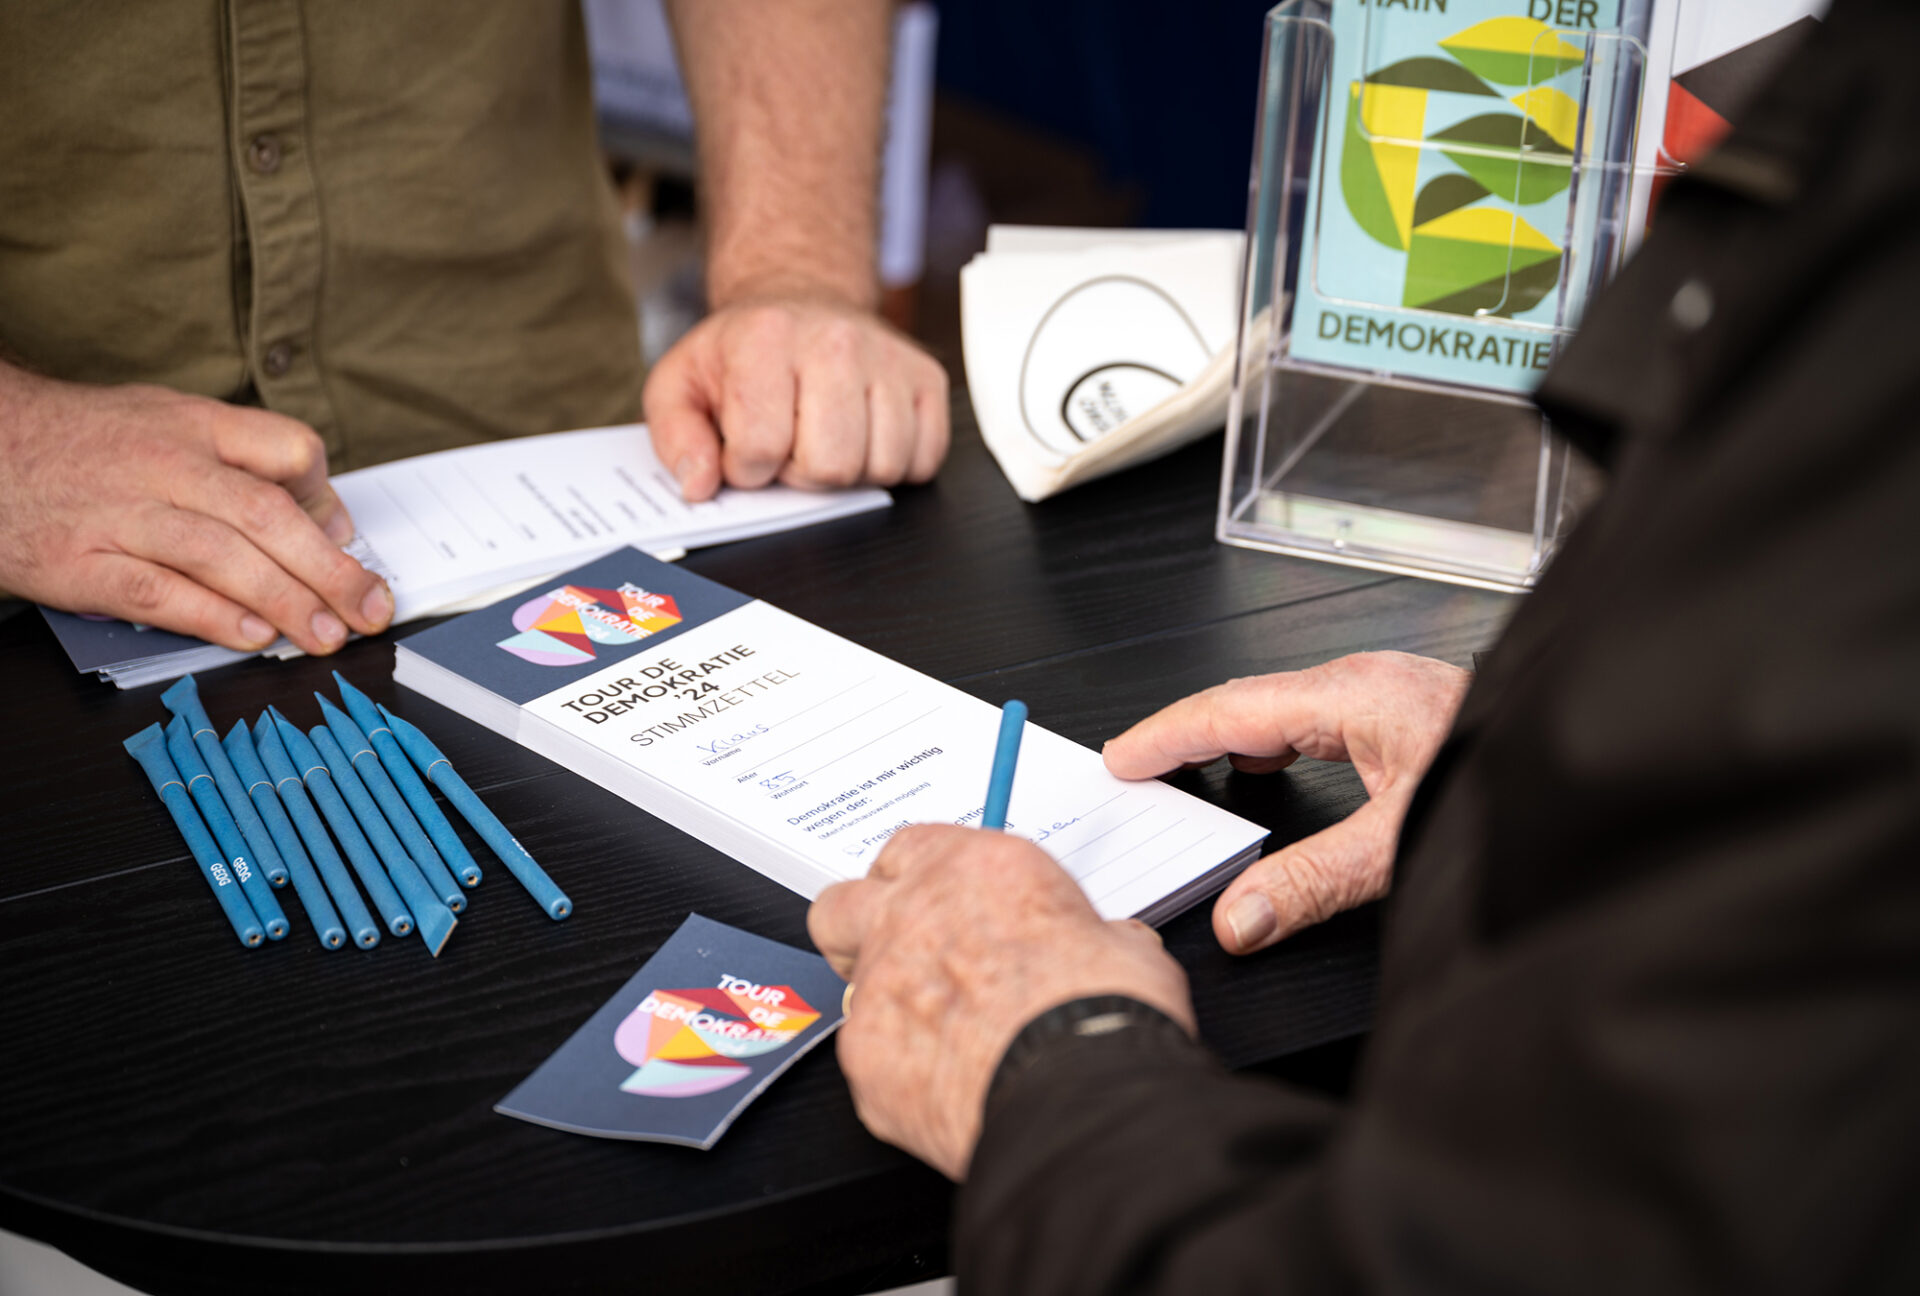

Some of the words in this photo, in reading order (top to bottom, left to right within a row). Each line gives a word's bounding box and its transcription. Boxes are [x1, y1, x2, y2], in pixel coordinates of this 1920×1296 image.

[1528, 0, 1599, 28] DER
[1317, 310, 1553, 371] DEMOKRATIE
[616, 581, 666, 609] TOUR
[547, 588, 653, 640] DEMOKRATIE
[627, 606, 656, 623] DE
[560, 677, 642, 713] TOUR
[640, 658, 683, 680] DE
[583, 644, 756, 725] DEMOKRATIE
[674, 681, 720, 701] '24
[630, 669, 801, 747] STIMMZETTEL
[702, 747, 742, 767] Vorname
[770, 780, 810, 800] Wohnort
[787, 789, 860, 826] Demokratie
[857, 779, 878, 791] ist
[876, 769, 897, 783] mir
[896, 746, 944, 772] wichtig
[803, 808, 847, 833] wegen
[846, 796, 873, 812] der:
[862, 819, 913, 846] Freiheit
[717, 973, 786, 1007] TOUR
[749, 1006, 787, 1028] DE
